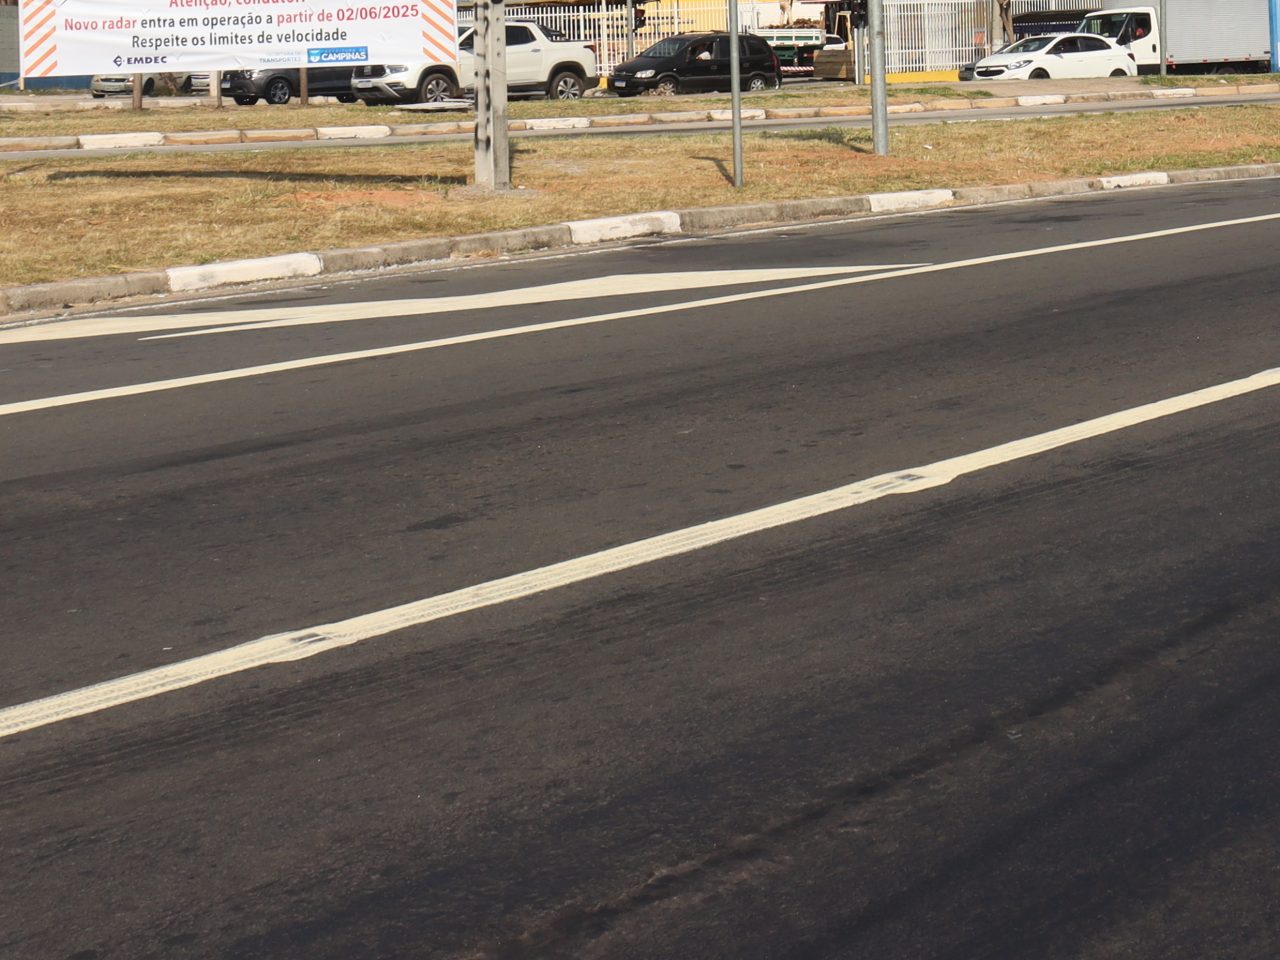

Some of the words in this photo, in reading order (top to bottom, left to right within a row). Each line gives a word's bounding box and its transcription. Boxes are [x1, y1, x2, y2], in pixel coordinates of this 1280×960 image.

[64, 18, 98, 31] Novo
[102, 16, 137, 30] radar
[140, 17, 175, 29] entra
[179, 17, 198, 28] em
[202, 14, 262, 30] operação
[266, 15, 273, 24] a
[277, 10, 314, 26] partir
[317, 9, 333, 22] de
[336, 4, 419, 22] 02/06/2025
[132, 34, 188, 50] Respeite
[192, 36, 206, 46] os
[209, 31, 253, 46] limites
[257, 30, 272, 44] de
[277, 28, 347, 43] velocidade
[126, 56, 168, 65] EMDEC
[322, 52, 366, 61] CAMPINAS
